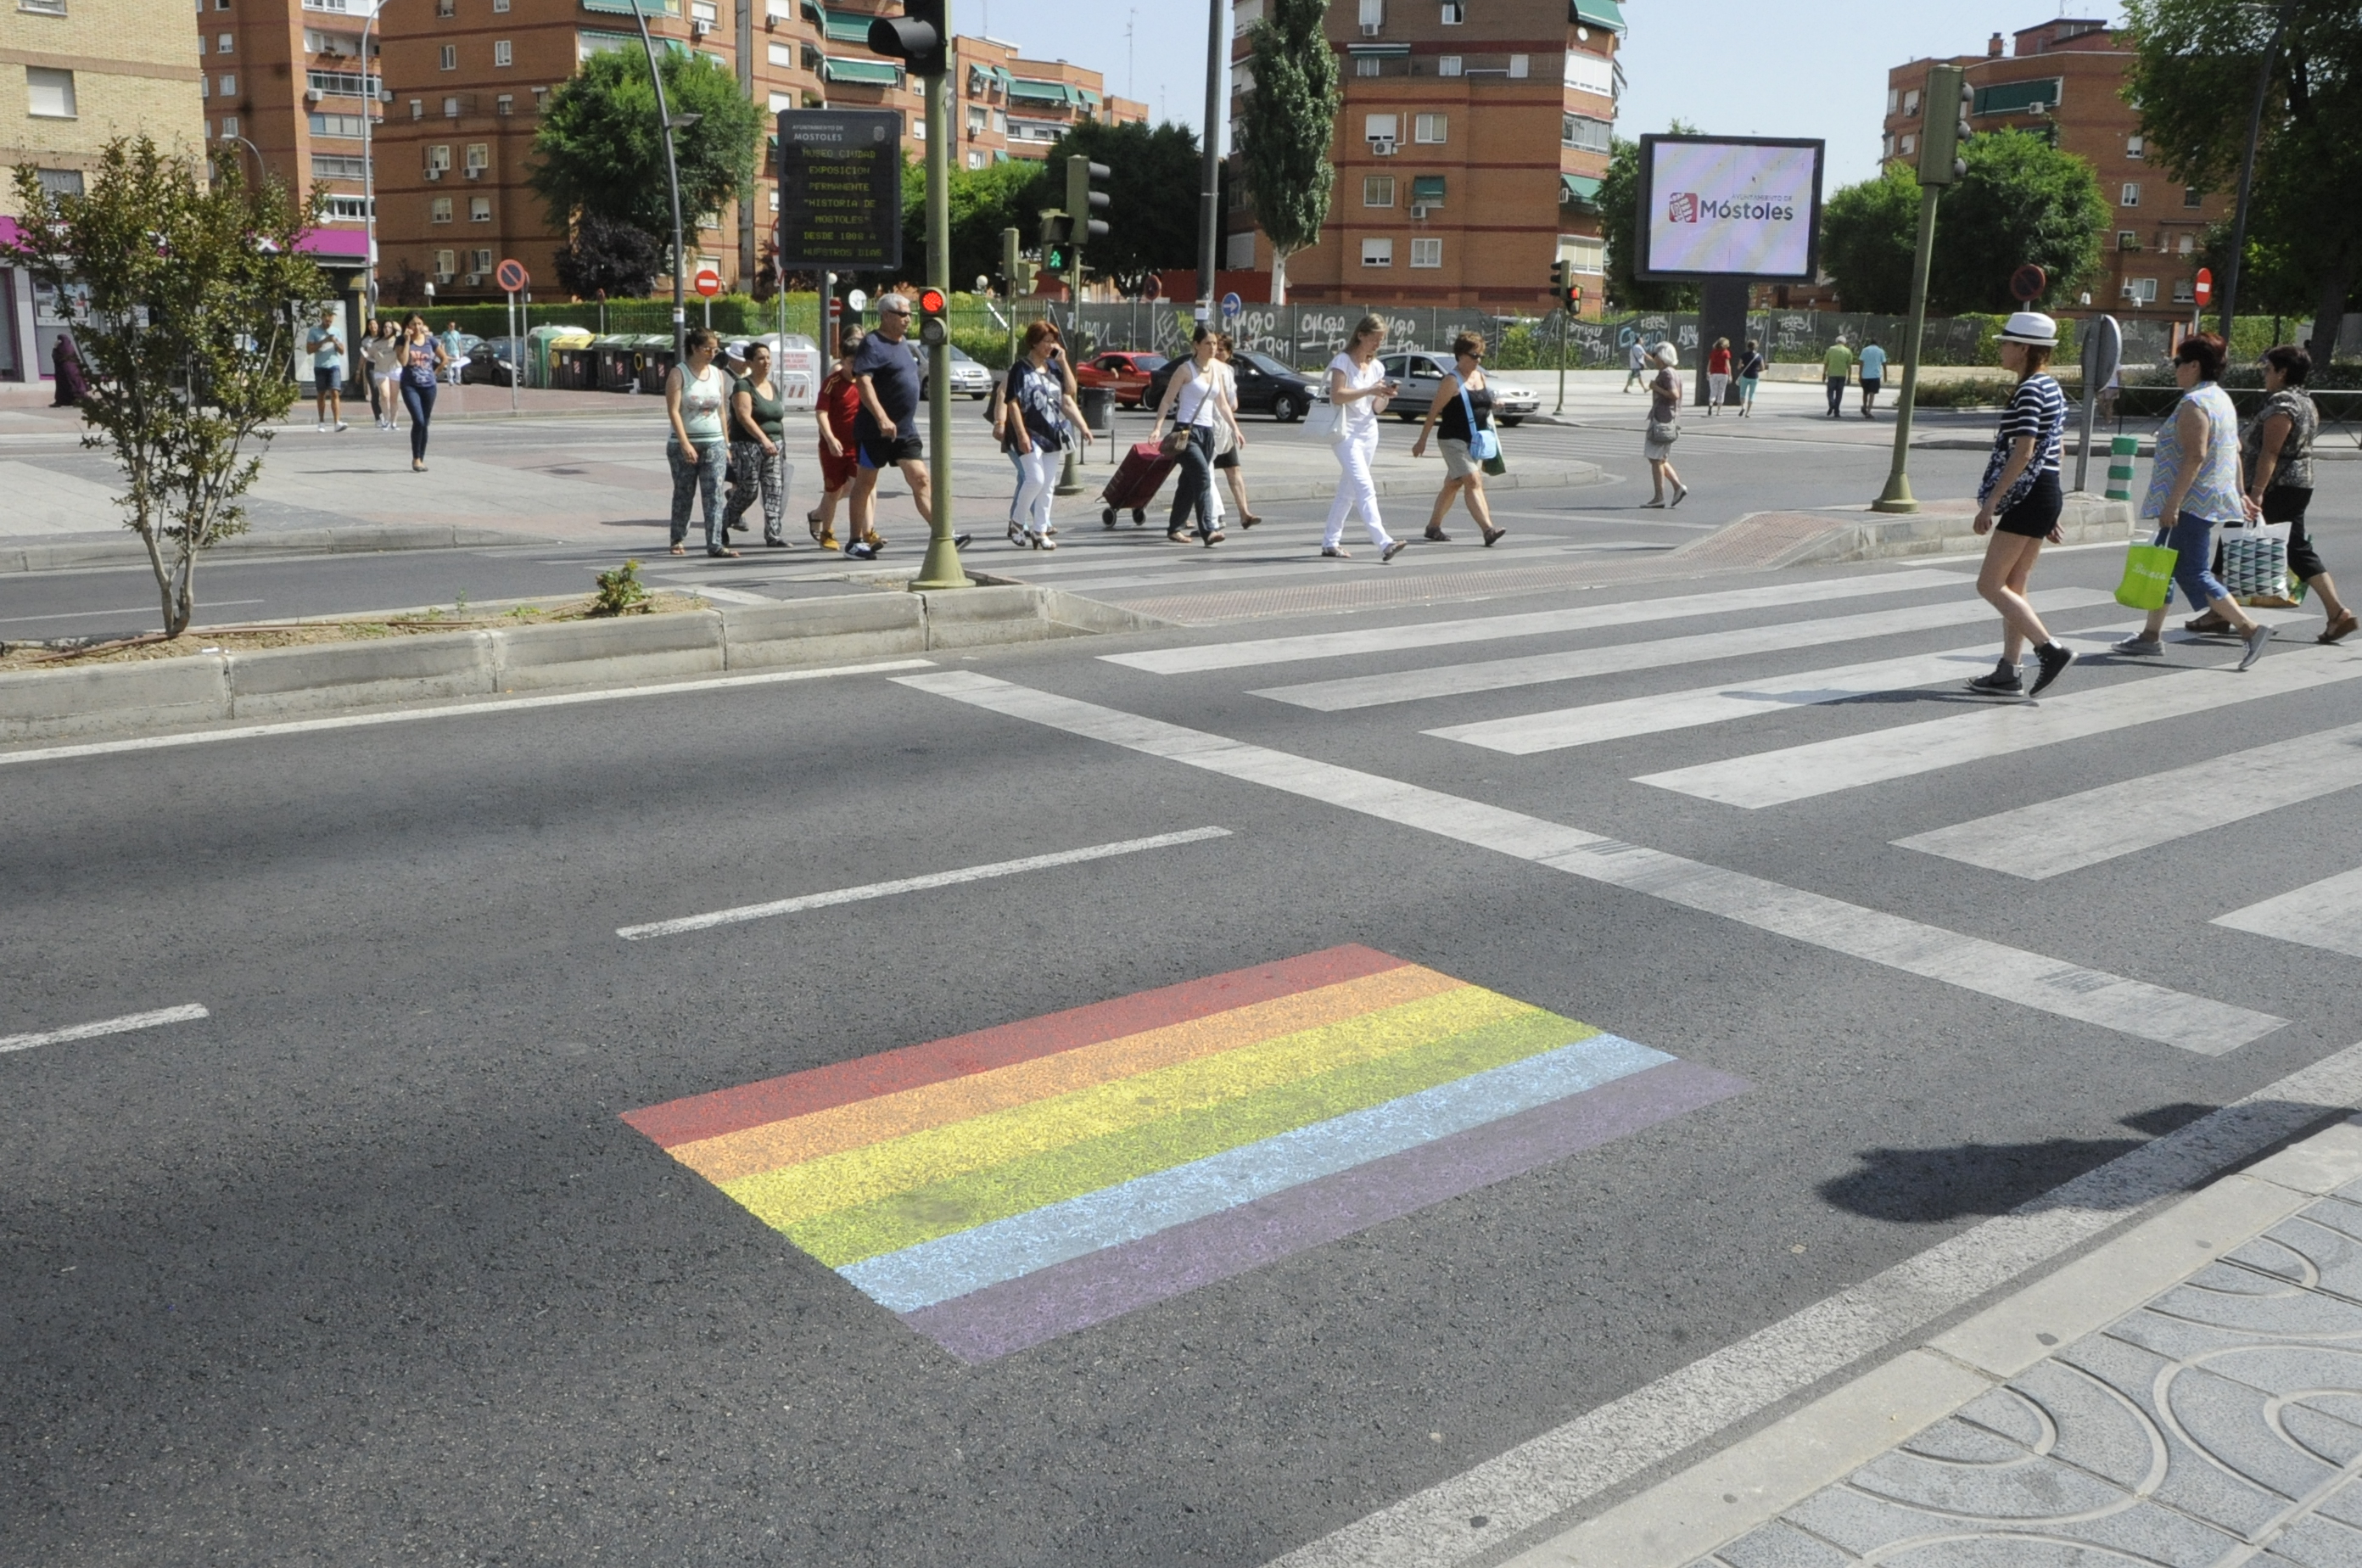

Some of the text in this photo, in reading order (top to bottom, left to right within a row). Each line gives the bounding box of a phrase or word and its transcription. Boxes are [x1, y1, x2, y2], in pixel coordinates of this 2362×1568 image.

[793, 133, 842, 142] MOSTOLES
[802, 148, 876, 159] MUSEO CIUDAD
[809, 165, 870, 175] EXPOSICION
[1732, 193, 1783, 202] AYUNTAMIENTO
[864, 199, 876, 208] DE
[1700, 199, 1794, 221] Móstoles
[803, 232, 834, 240] DESDE
